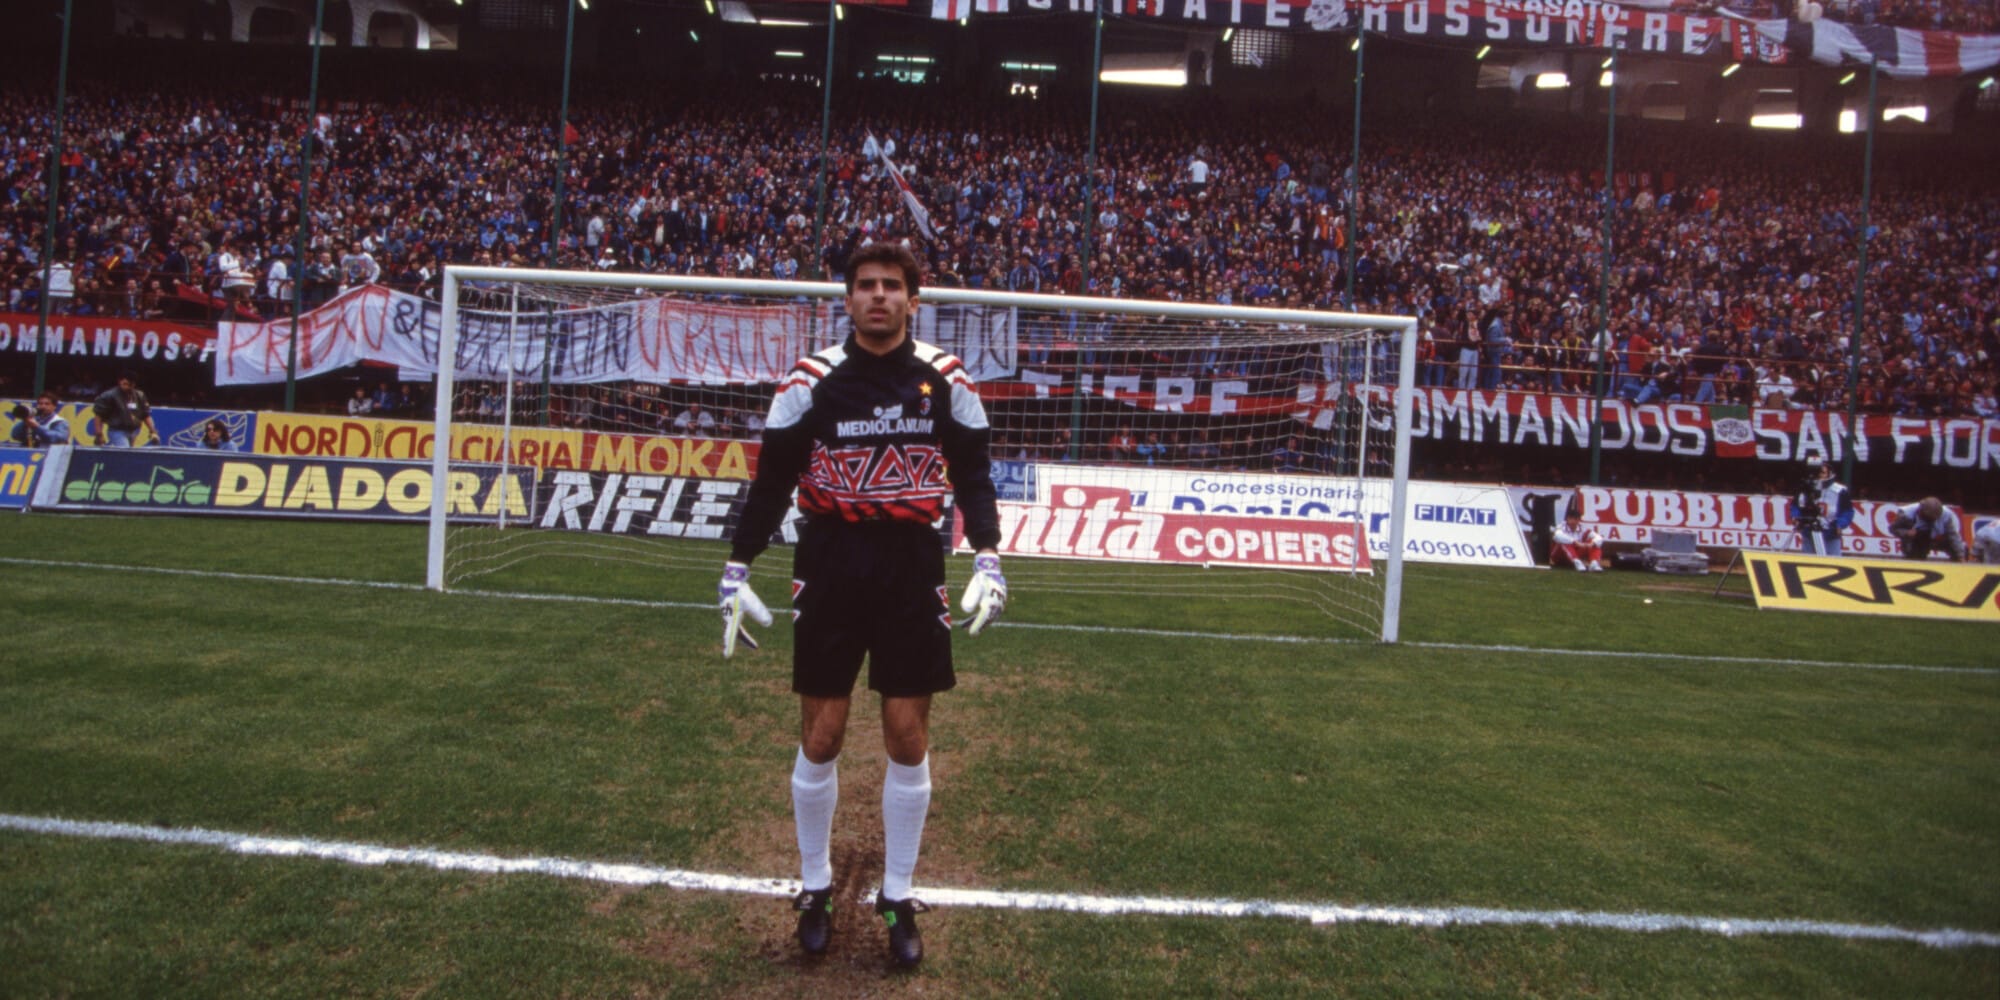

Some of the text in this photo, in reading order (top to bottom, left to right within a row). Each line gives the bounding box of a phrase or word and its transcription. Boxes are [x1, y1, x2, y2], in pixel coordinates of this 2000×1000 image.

[394, 300, 418, 340] &
[837, 418, 934, 437] MEDIOLANUM
[1355, 383, 1706, 456] COMMANDOS
[1753, 408, 1869, 463] SAN
[590, 434, 751, 480] MOKA
[214, 461, 528, 516] DIADORA
[540, 471, 742, 539] RIFLE
[1190, 478, 1365, 500] Concessionaria
[1417, 505, 1495, 525] FIAT
[1174, 526, 1360, 566] COPIERS
[1406, 539, 1517, 560] 40910148
